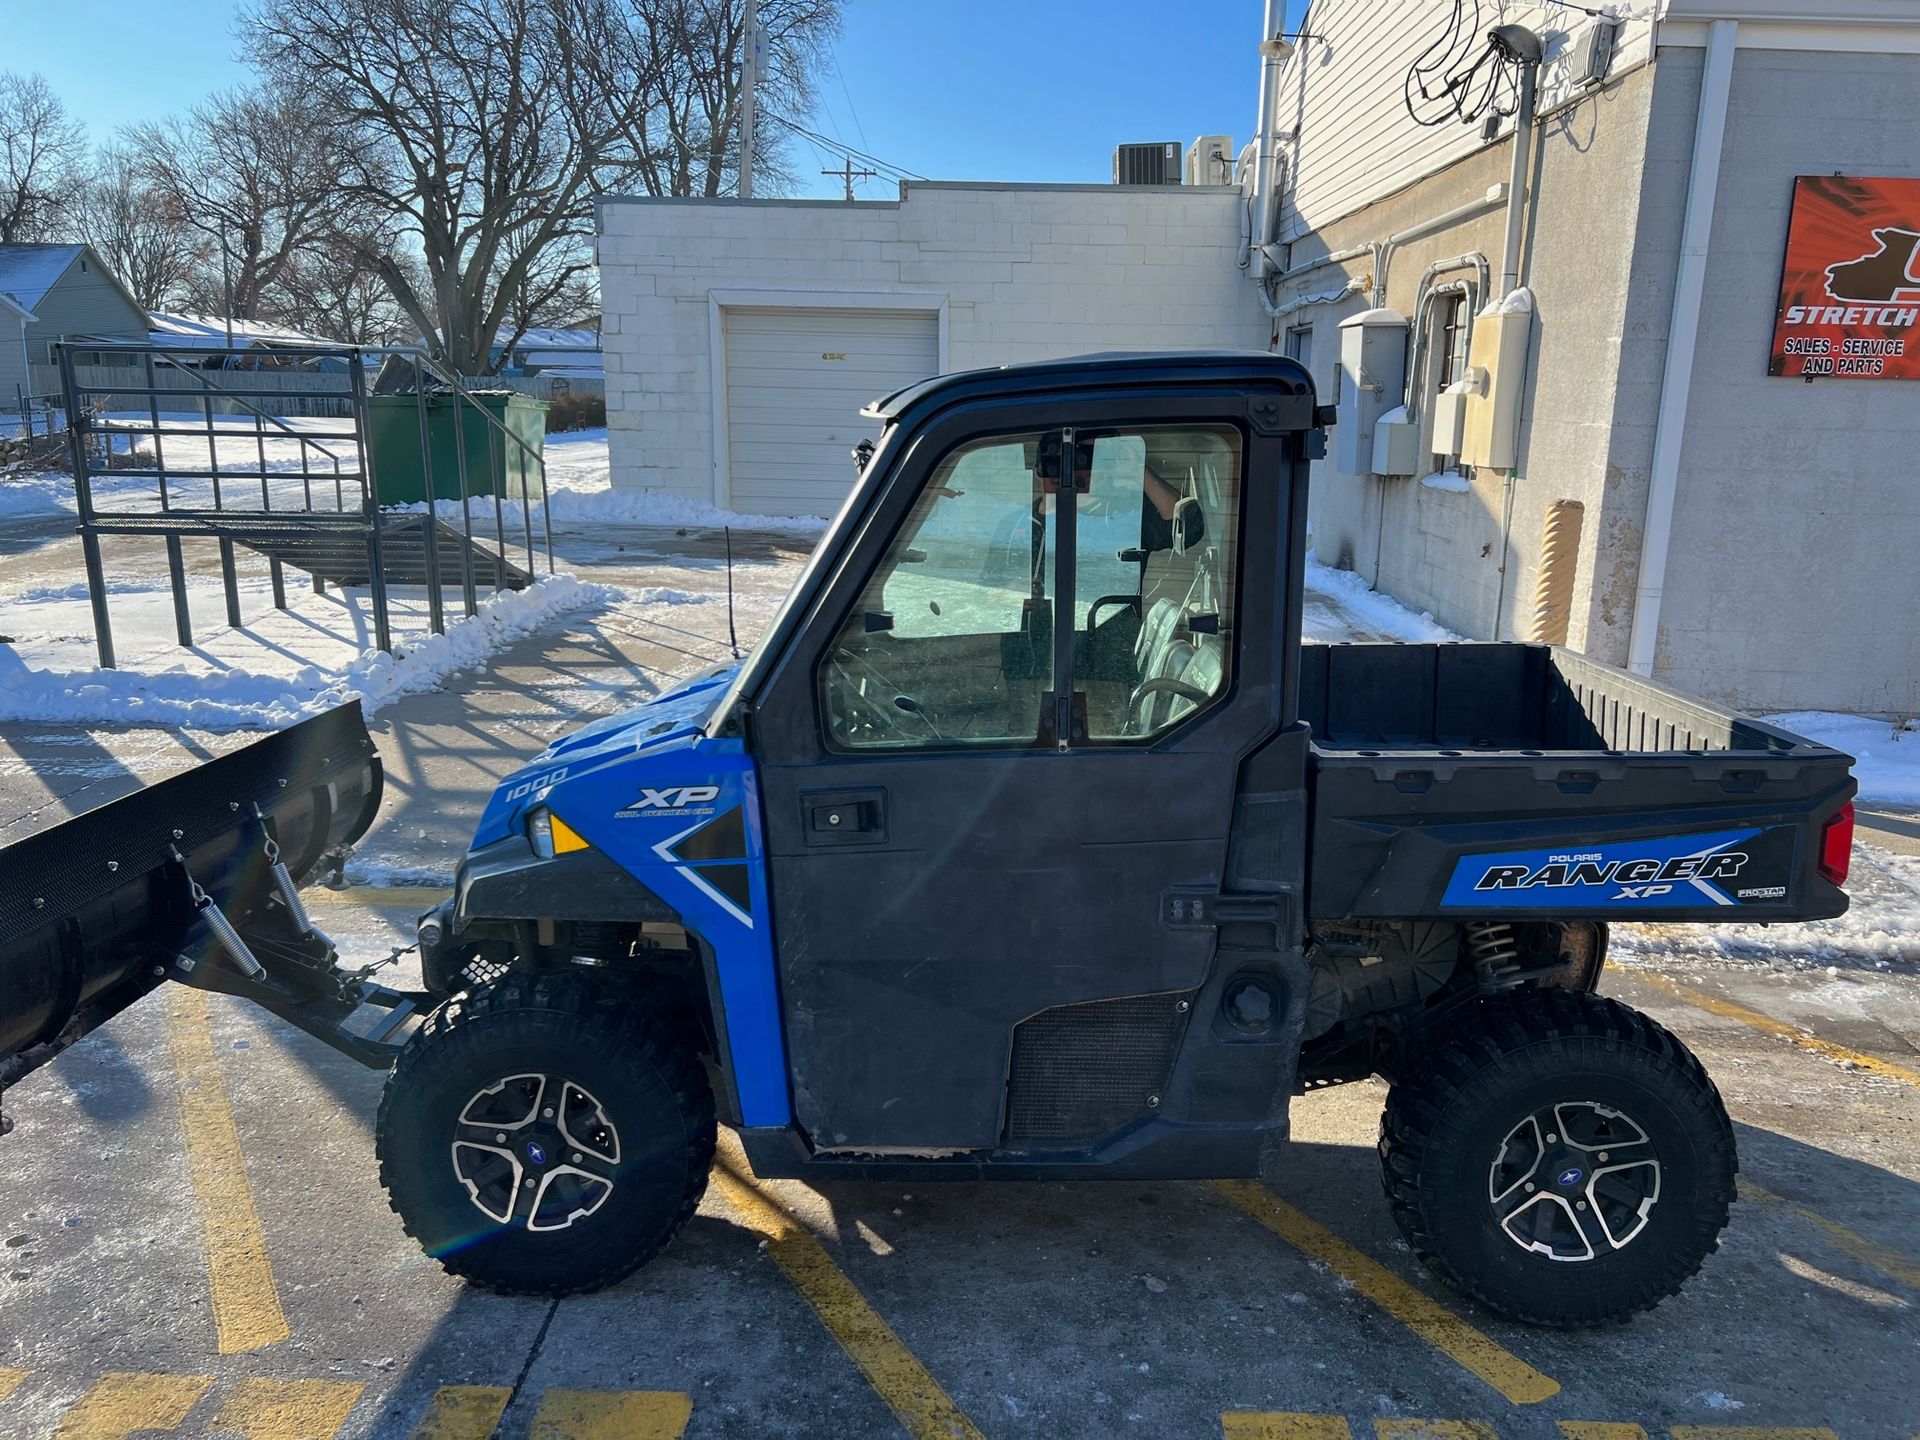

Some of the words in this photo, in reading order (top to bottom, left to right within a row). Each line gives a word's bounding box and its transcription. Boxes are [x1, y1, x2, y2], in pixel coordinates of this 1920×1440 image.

[1784, 306, 1918, 326] STRETCH
[1785, 338, 1830, 354] SALES
[1842, 339, 1904, 355] SERVICE
[1802, 358, 1833, 374] AND
[1837, 358, 1883, 374] PARTS
[505, 767, 569, 803] 1000
[626, 785, 720, 809] XP
[1549, 853, 1602, 863] POLARIS
[1474, 852, 1749, 890] RANGER
[1610, 885, 1673, 899] XP
[1737, 886, 1786, 897] PROSTAR
